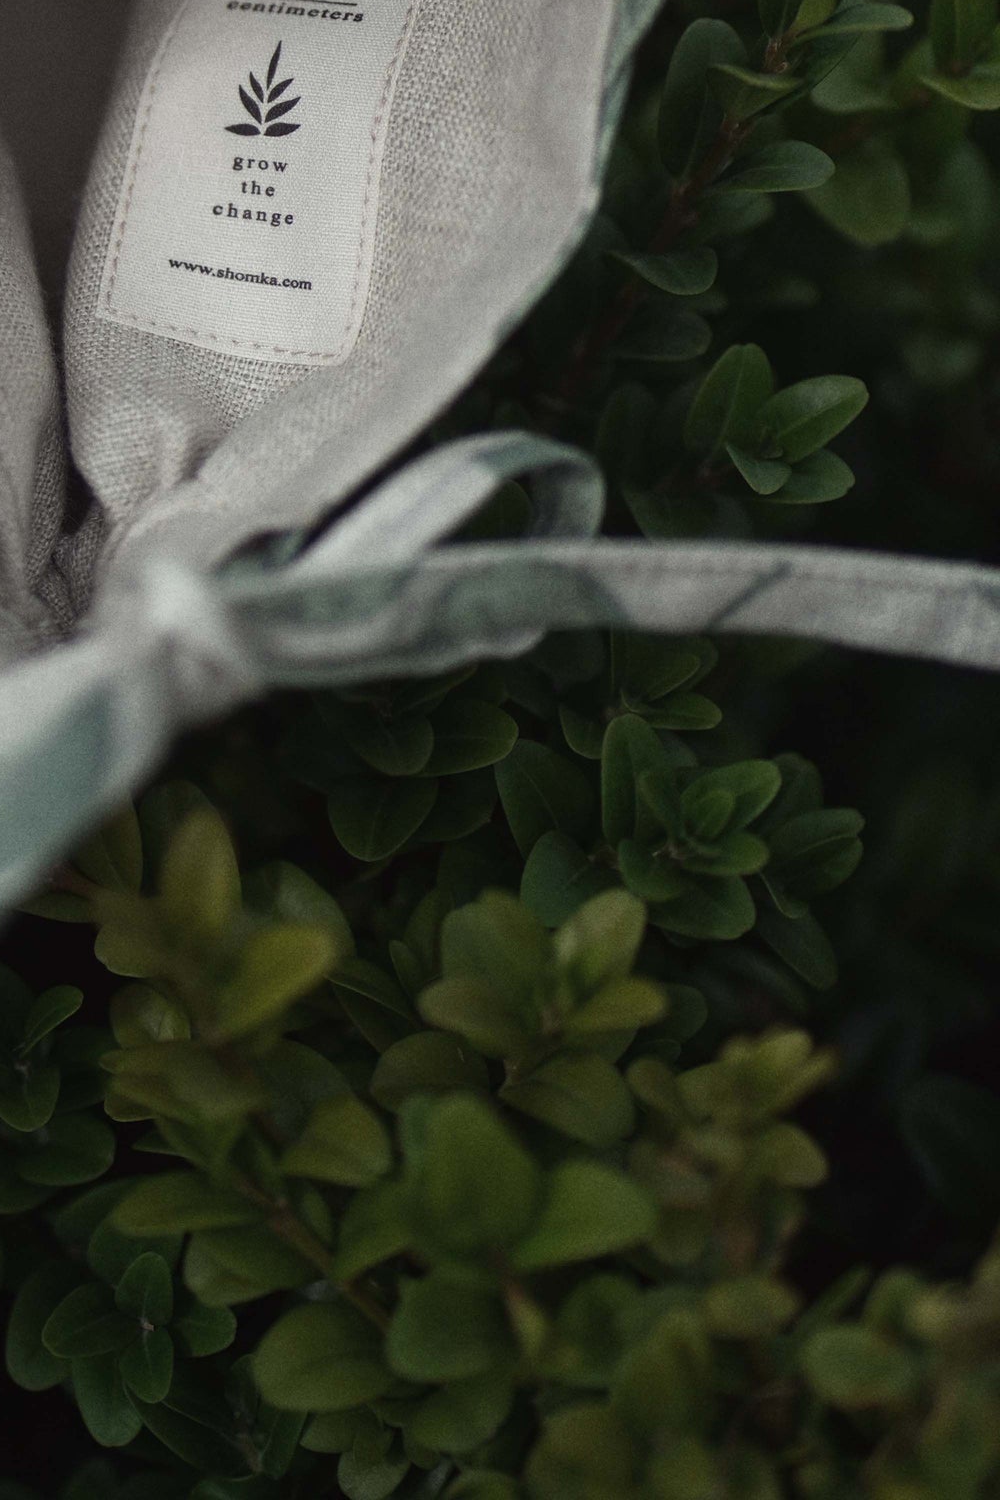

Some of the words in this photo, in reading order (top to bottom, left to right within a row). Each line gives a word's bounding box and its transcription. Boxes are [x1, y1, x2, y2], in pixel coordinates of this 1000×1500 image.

[226, 0, 364, 23] centimeters
[232, 156, 289, 173] grow
[241, 181, 276, 197] the
[212, 202, 294, 227] change
[168, 258, 313, 290] www.shomka.com
